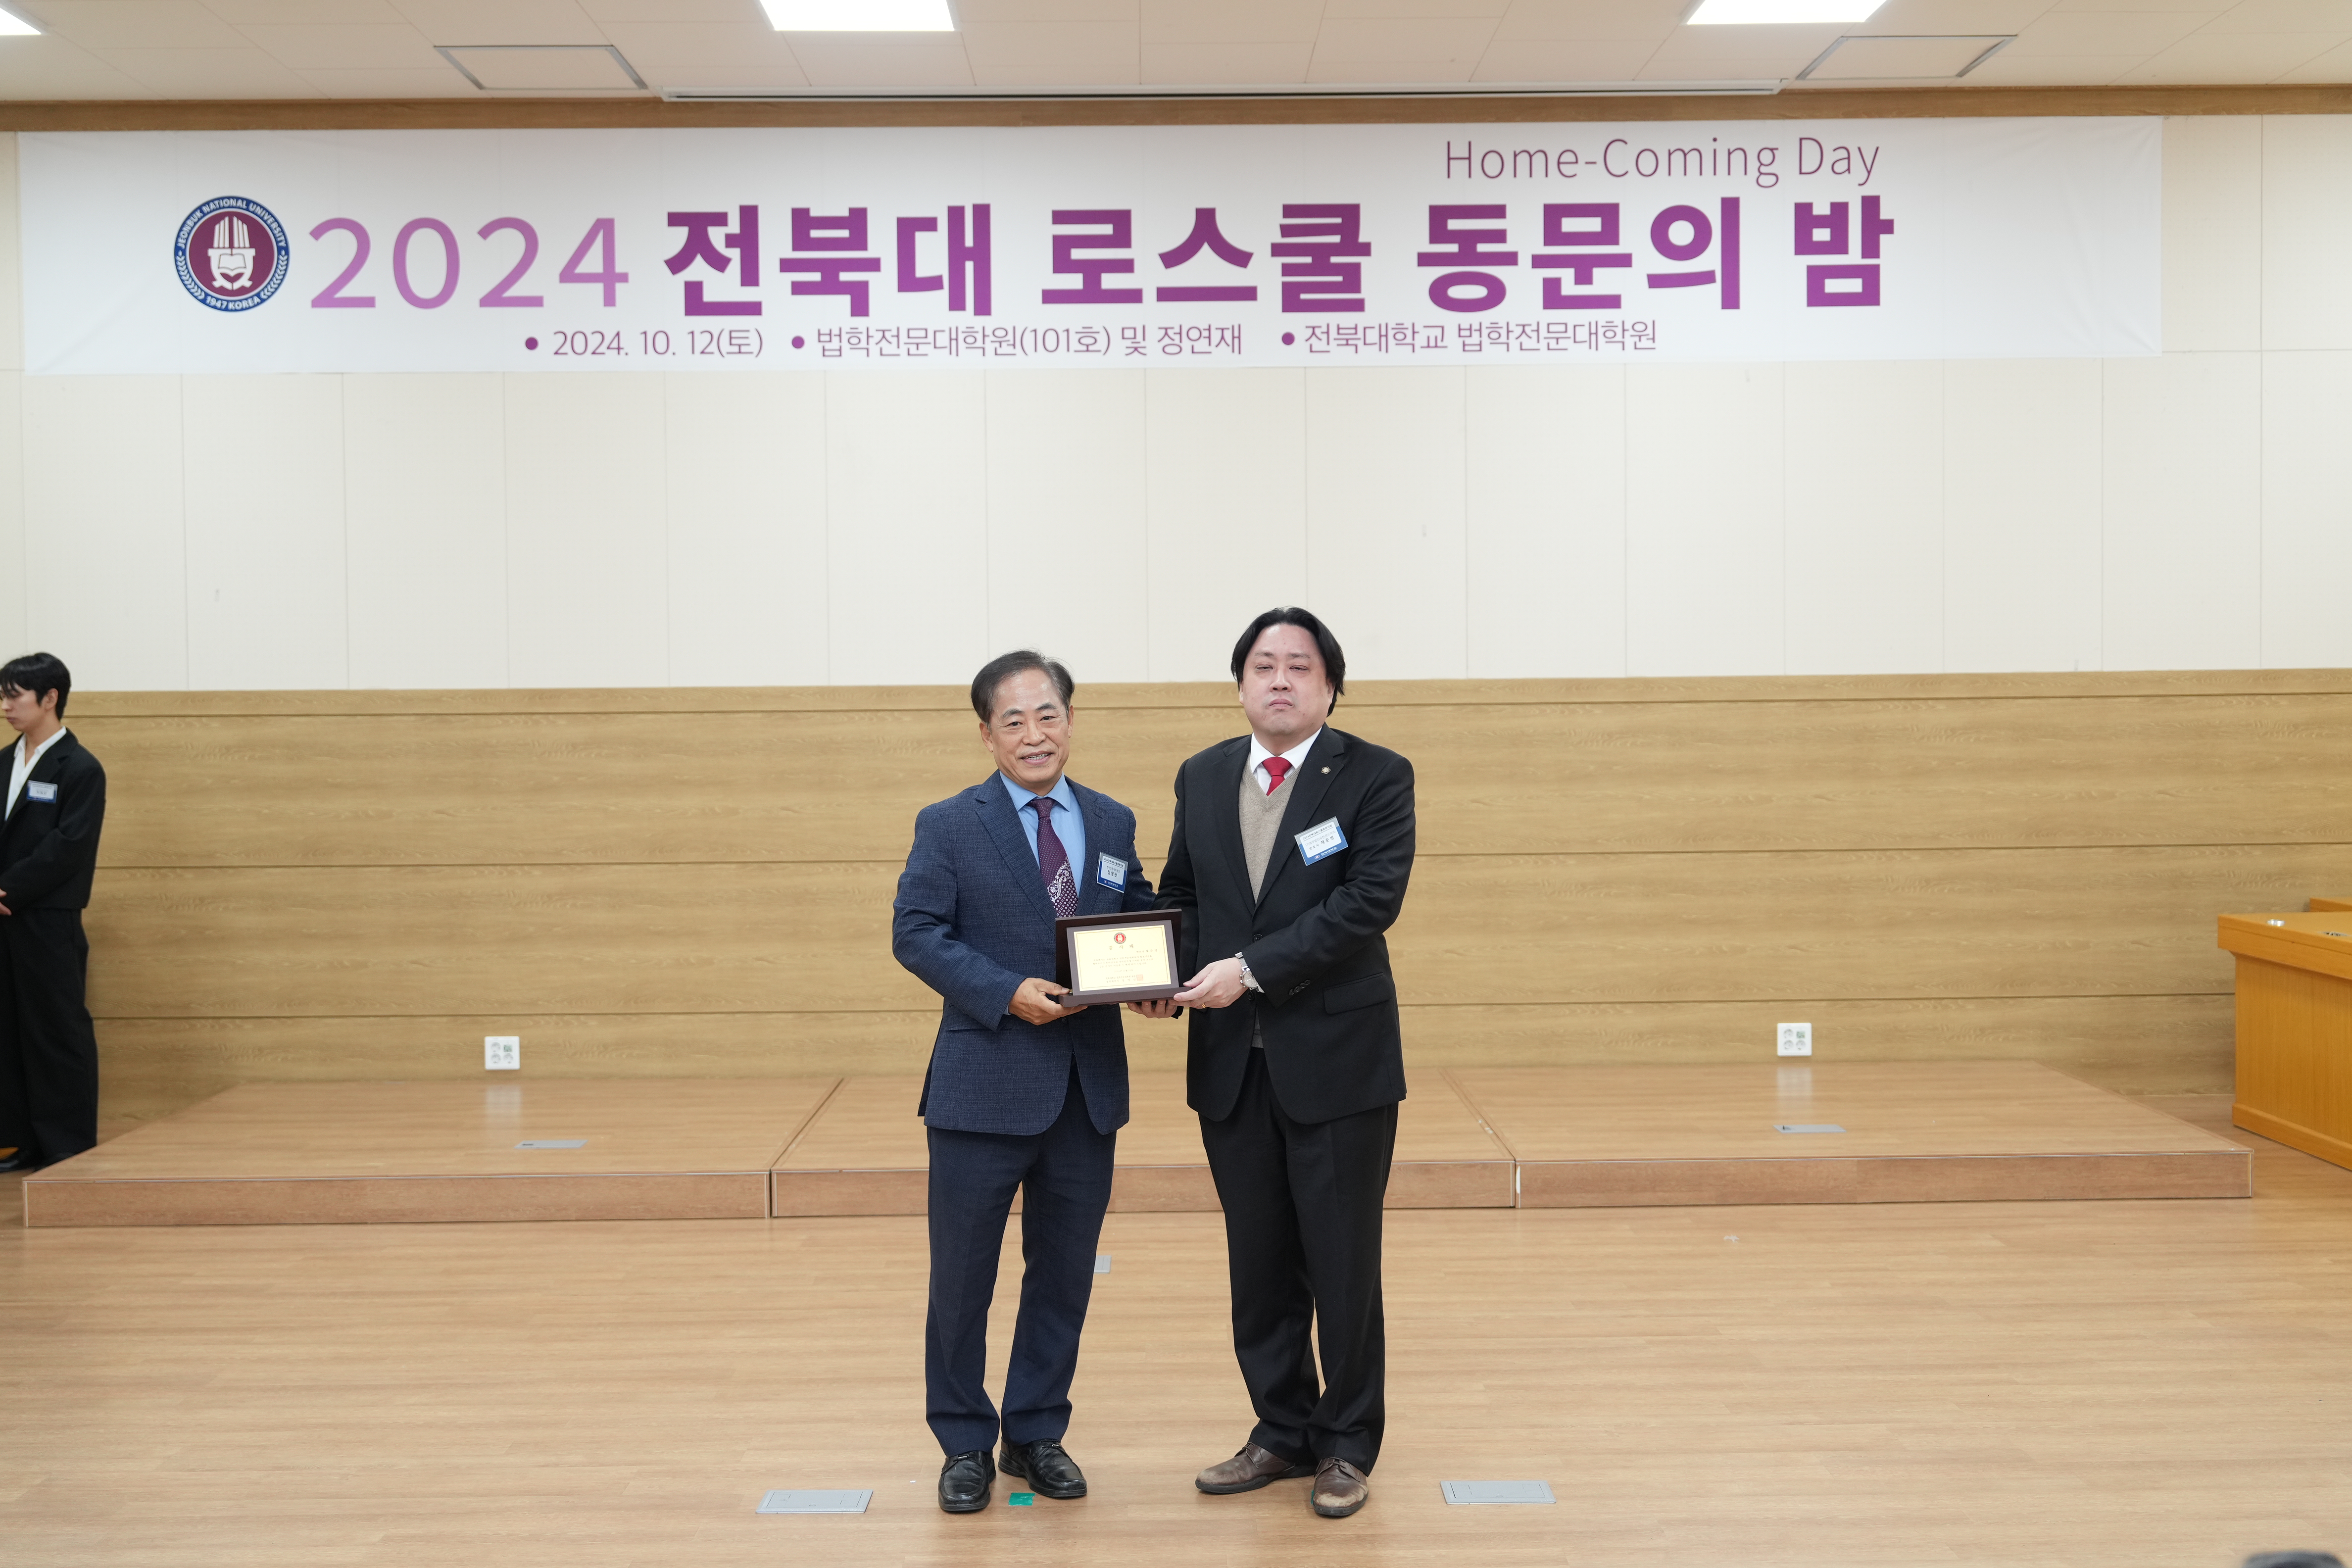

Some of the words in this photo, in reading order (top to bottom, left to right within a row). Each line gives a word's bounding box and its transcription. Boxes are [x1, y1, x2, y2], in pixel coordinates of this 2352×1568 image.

[1446, 138, 1780, 188] Home-Coming
[1799, 137, 1880, 186] Day
[176, 209, 203, 249] JEONBUK
[202, 198, 247, 213] NATIONAL
[249, 202, 287, 247] UNIVERSITY
[309, 216, 630, 310] 2024
[663, 204, 992, 317] 전북대
[1041, 203, 1372, 313] 로스쿨
[1417, 196, 1741, 313] 동문의
[1794, 195, 1895, 307] 밤
[206, 295, 228, 310] 1947
[228, 297, 261, 310] KOREA
[552, 330, 629, 356] 2024.
[642, 331, 677, 355] 10.
[690, 329, 764, 358] 12(토)
[817, 325, 1111, 357] 법학전문대학원(101호)
[1121, 324, 1147, 356] 및
[1157, 324, 1242, 355] 정연재
[1304, 323, 1447, 354] 전북대학교
[1458, 321, 1656, 353] 법학전문대학원
